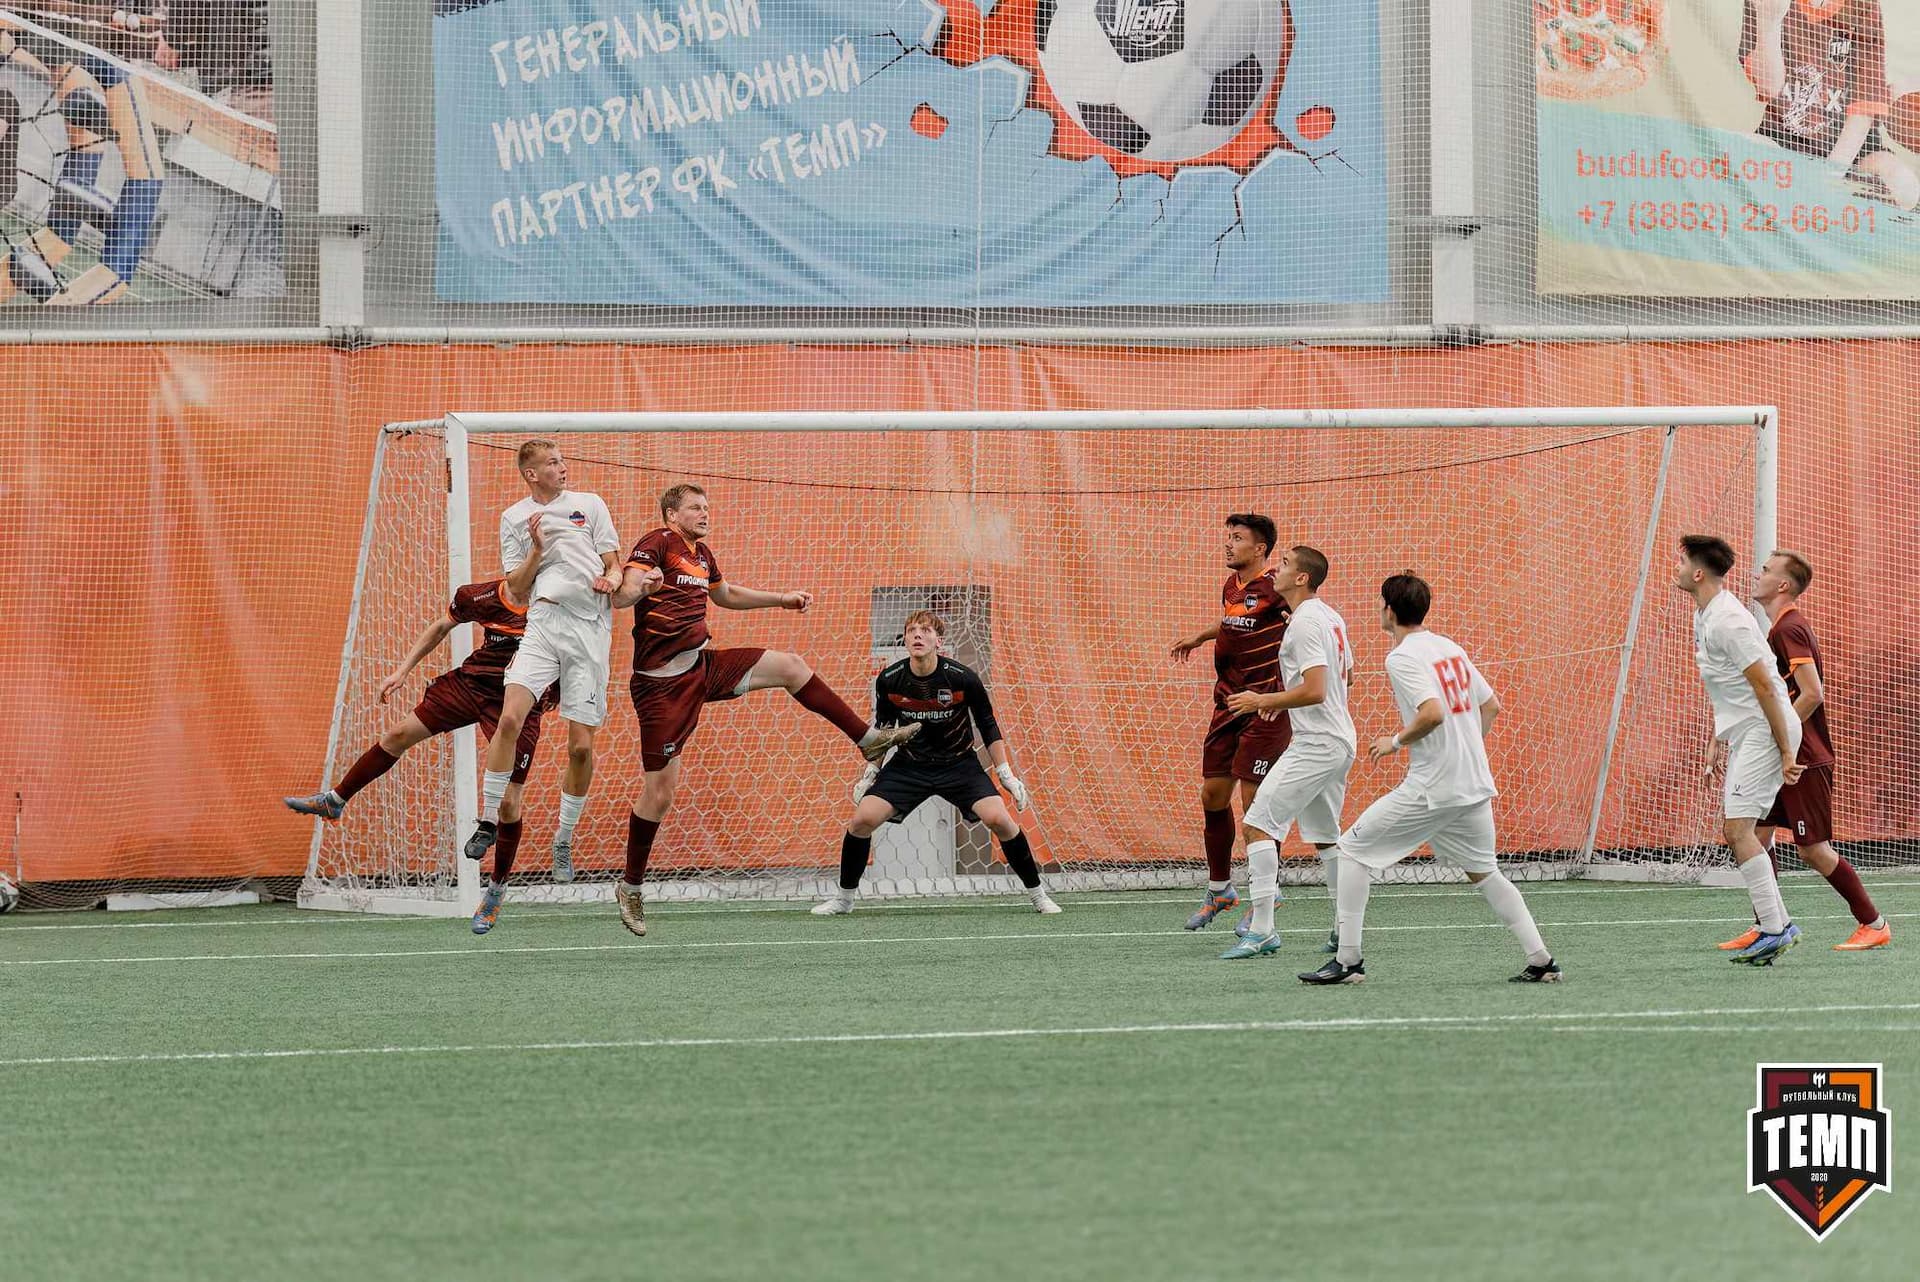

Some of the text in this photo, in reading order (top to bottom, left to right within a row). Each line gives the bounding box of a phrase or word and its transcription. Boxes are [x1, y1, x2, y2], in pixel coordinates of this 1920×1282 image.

[489, 0, 761, 88] ГЕНЕРАЛЬНЫЙ
[491, 36, 862, 172] ИНФОРМАЦИОННЫЙ
[491, 118, 887, 248] ПАРТНЕР ФК «ТЕМП»
[1576, 148, 1793, 189] budufood.org
[1577, 200, 1876, 239] +7 (3852) 22-66-01
[520, 753, 530, 769] 3
[1252, 759, 1269, 776] 22
[1797, 820, 1806, 836] 6
